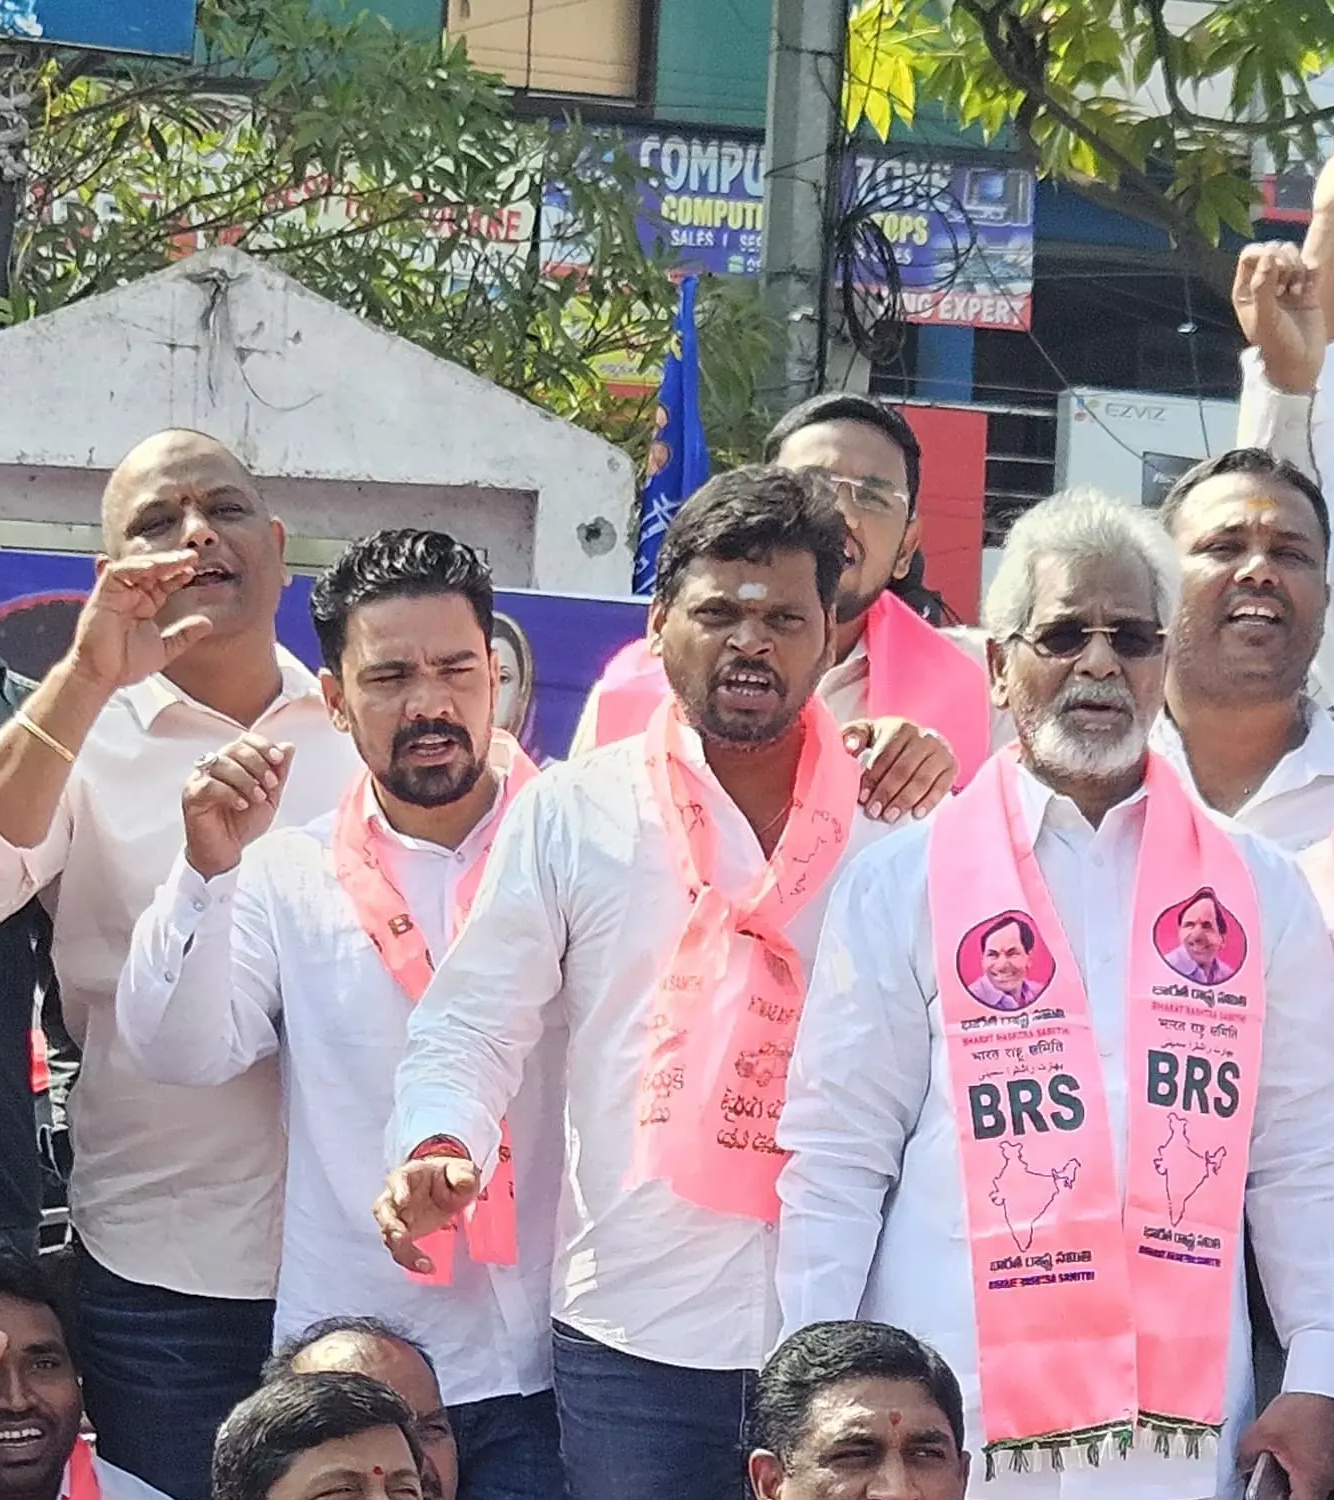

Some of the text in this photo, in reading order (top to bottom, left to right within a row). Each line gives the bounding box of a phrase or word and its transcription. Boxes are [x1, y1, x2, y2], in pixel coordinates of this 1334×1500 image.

[938, 295, 1026, 325] EXPERT
[1105, 402, 1167, 422] EZVIZ
[967, 1073, 1085, 1140] BRS
[1146, 1049, 1241, 1119] BRS
